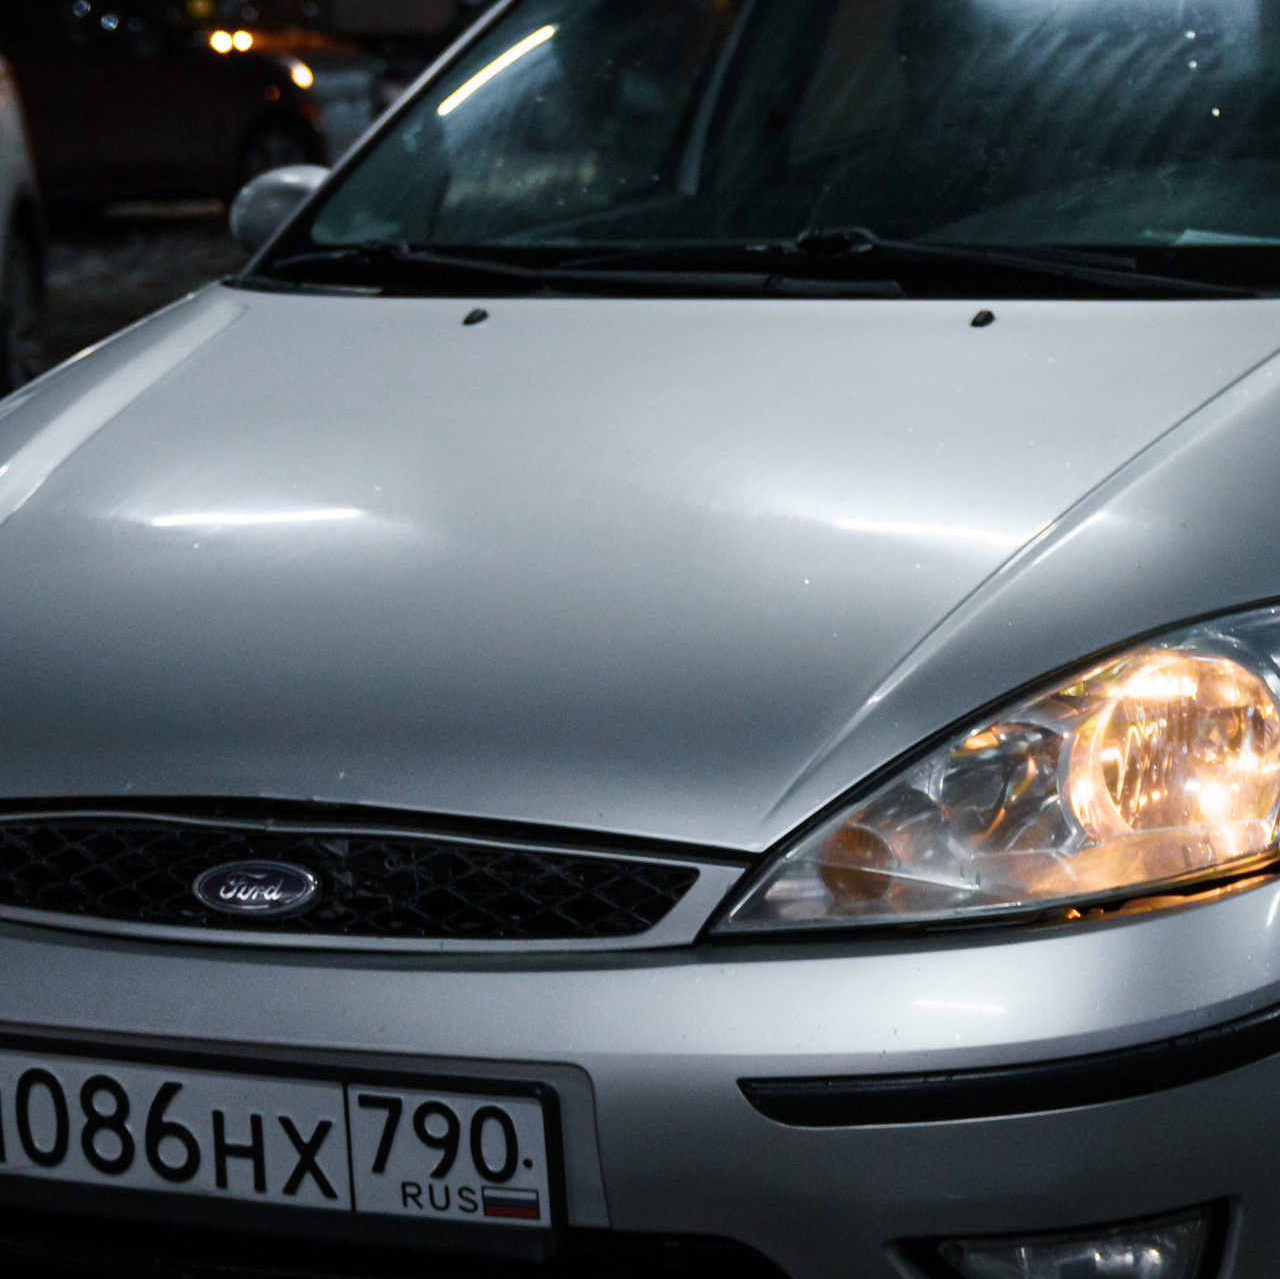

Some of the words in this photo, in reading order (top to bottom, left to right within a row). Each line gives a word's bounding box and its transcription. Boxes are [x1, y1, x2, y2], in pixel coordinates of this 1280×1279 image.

[219, 871, 284, 901] Ford
[0, 1067, 338, 1200] 086HX
[402, 1181, 479, 1214] RUS
